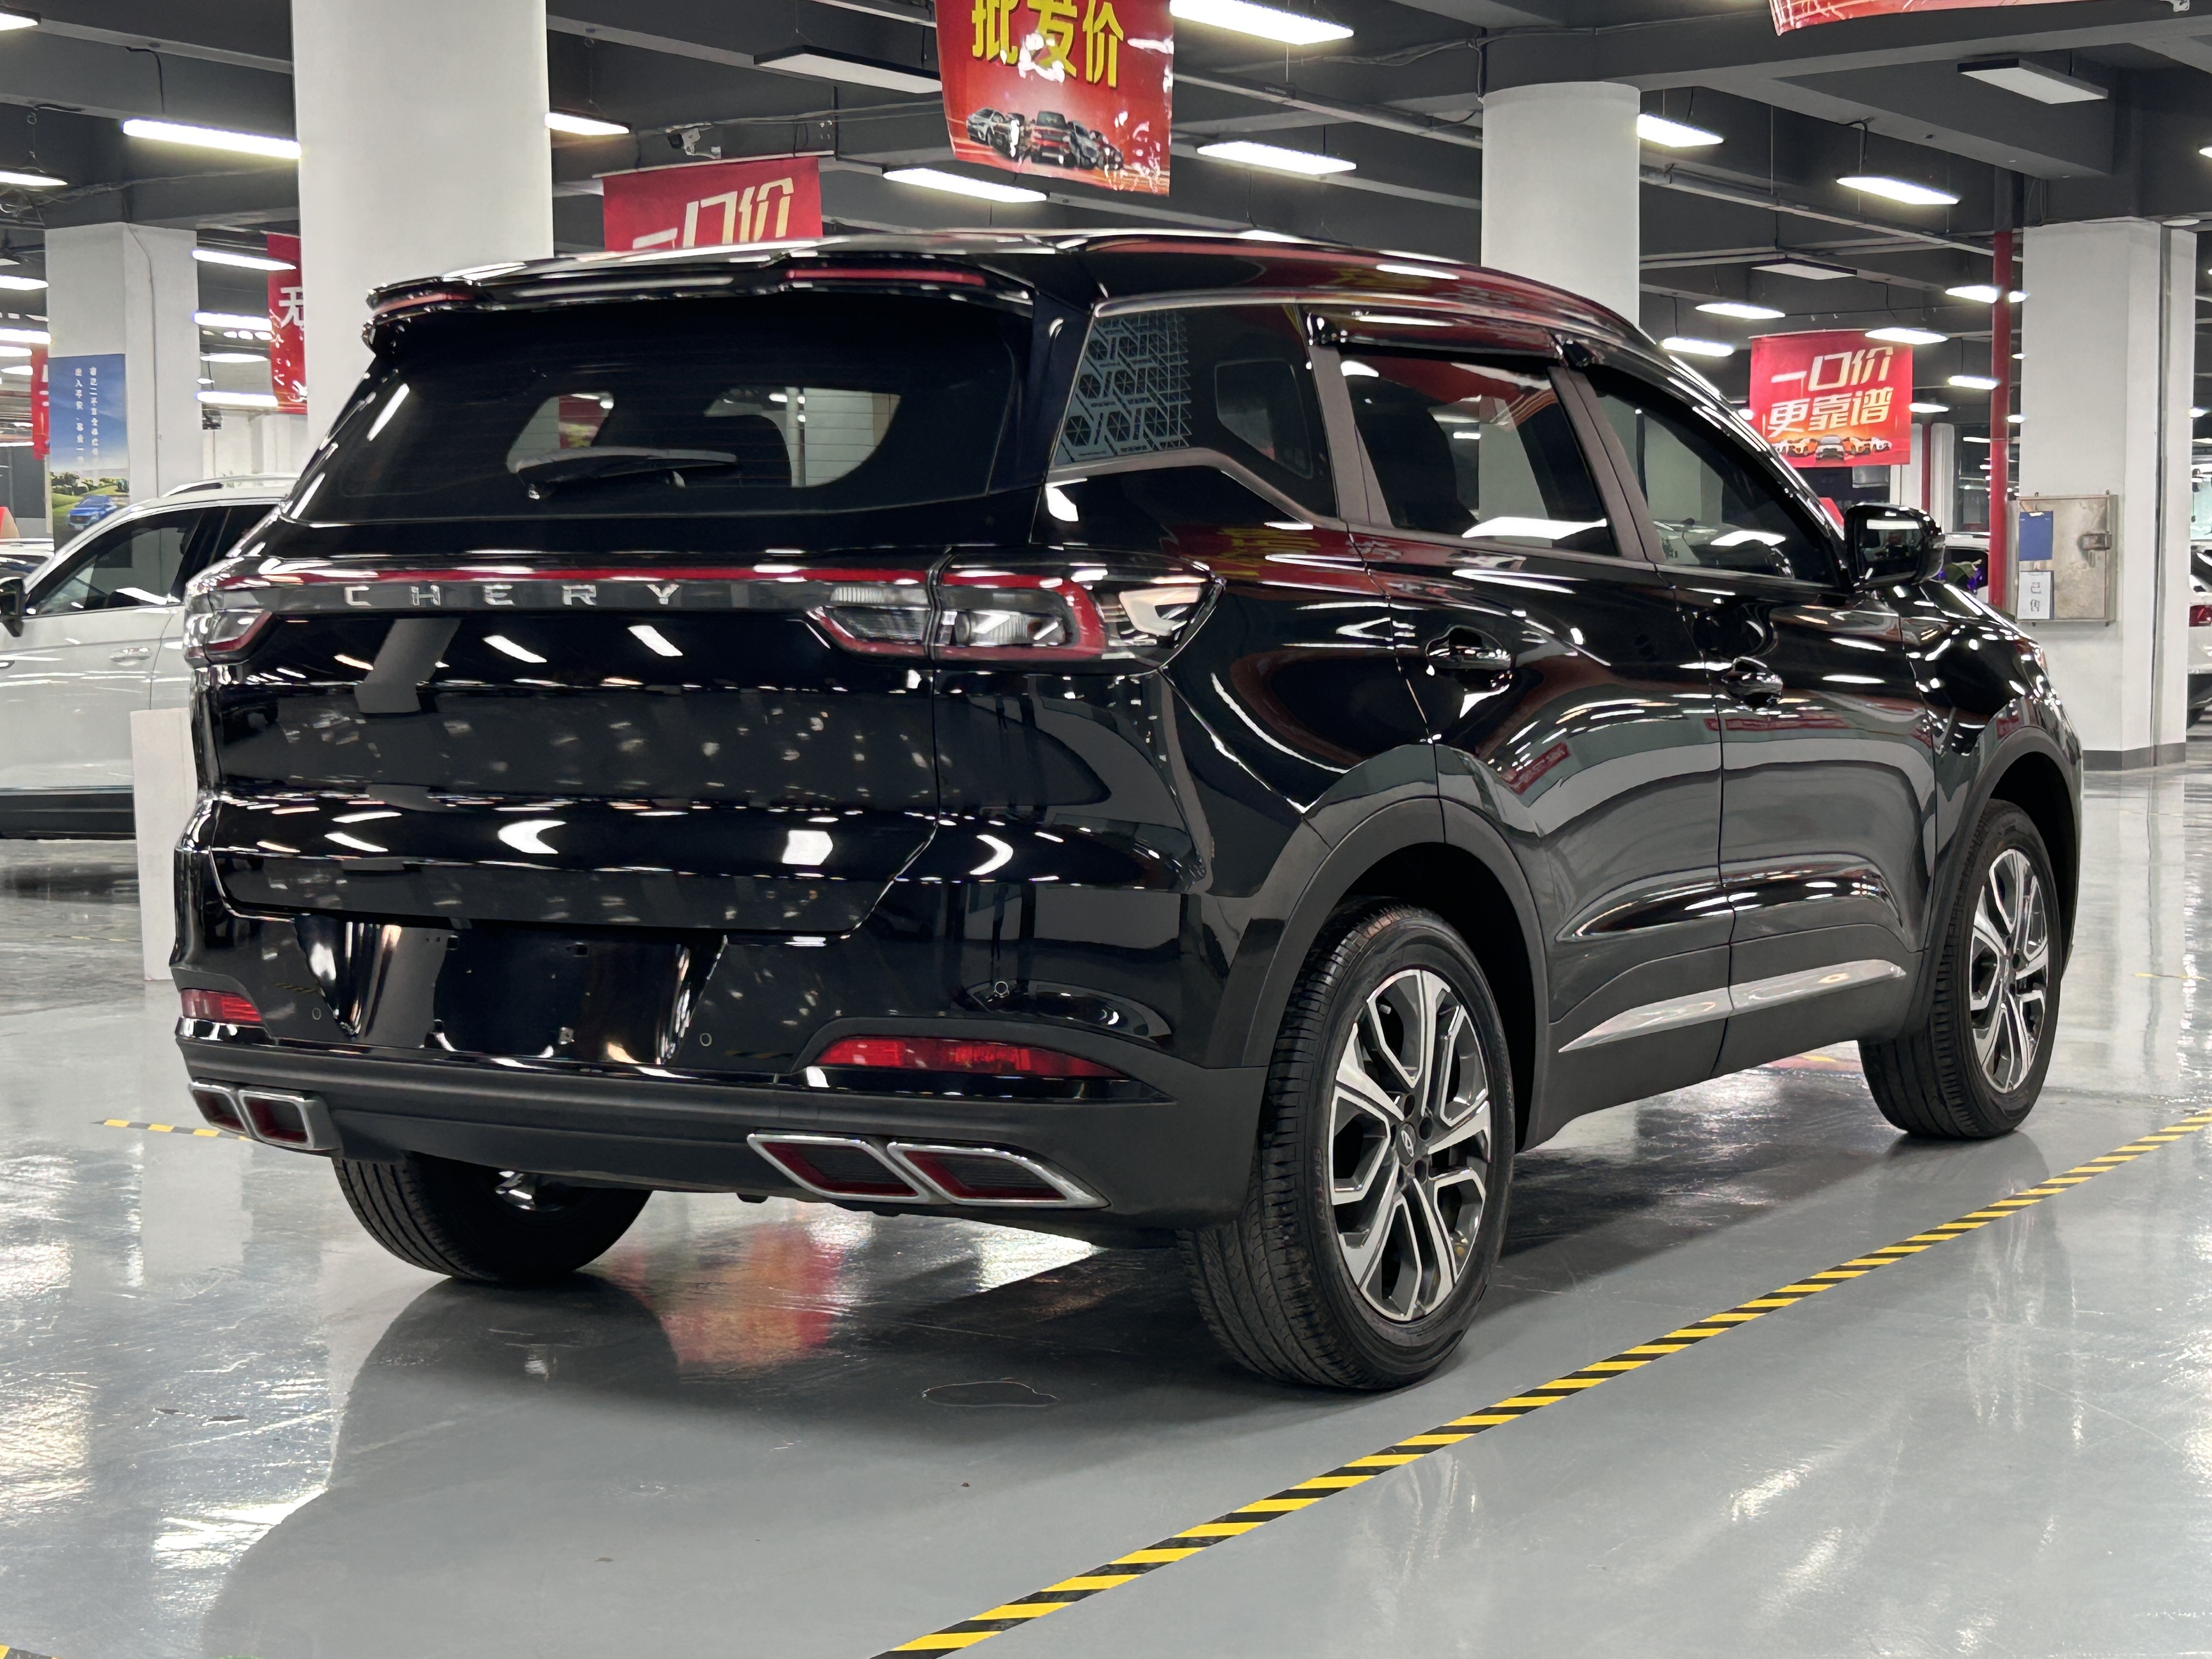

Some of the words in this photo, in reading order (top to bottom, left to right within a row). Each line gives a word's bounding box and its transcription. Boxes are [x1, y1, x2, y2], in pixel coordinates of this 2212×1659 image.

[972, 0, 1124, 88] 批发价
[1771, 346, 1893, 392] 一口价
[1767, 387, 1894, 438] 更靠谱
[344, 584, 680, 606] CHERY
